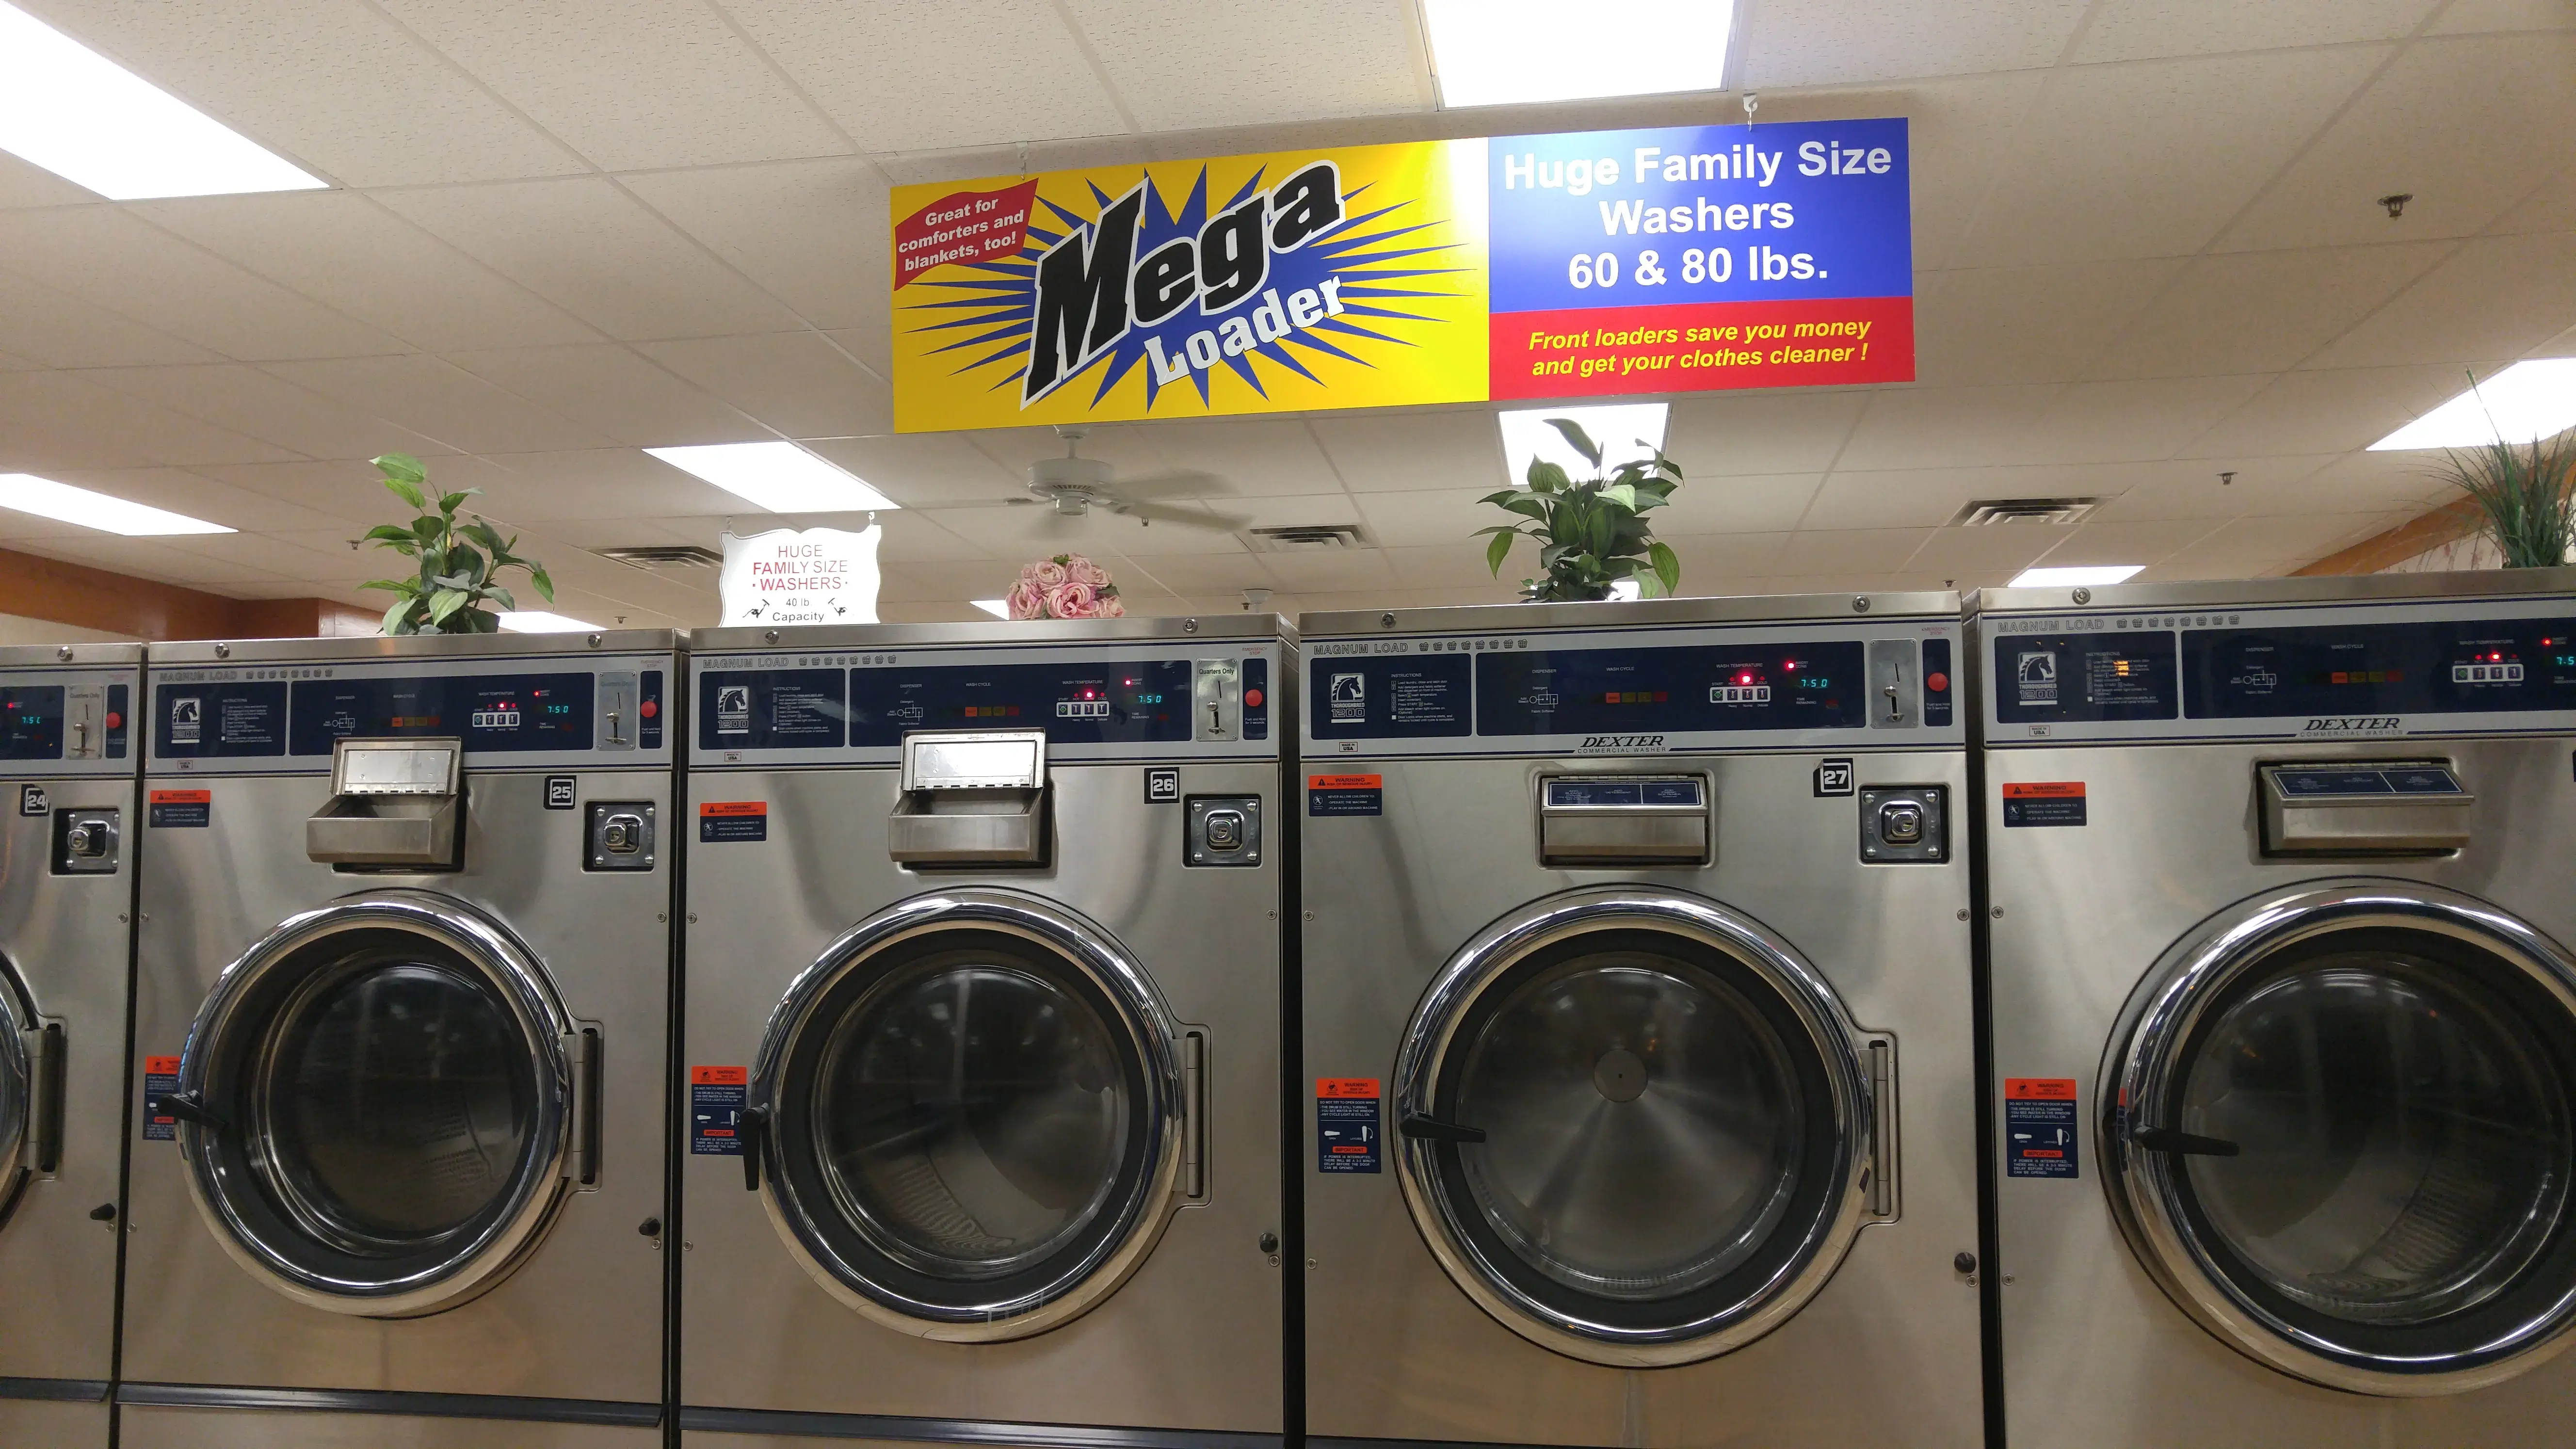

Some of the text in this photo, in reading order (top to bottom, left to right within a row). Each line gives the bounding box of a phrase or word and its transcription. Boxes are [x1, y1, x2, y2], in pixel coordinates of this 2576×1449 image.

[1505, 141, 1891, 195] Huge Family Size
[925, 198, 998, 226] Great for
[1599, 197, 1794, 236] Washers
[899, 209, 1024, 253] comforters and
[905, 231, 1016, 272] blankets, too!
[1568, 245, 1828, 289] 60 & 80 lbs.
[1019, 160, 1346, 411] Mega
[1144, 275, 1344, 387] Loader
[1529, 321, 1871, 350] Front loaders save you money
[1532, 356, 1574, 376] and
[1579, 354, 1616, 378] get
[1622, 354, 1674, 376] your
[1680, 350, 1763, 368] clothes
[778, 545, 822, 558] HUGE
[753, 561, 848, 575] FAMILY SIZE
[773, 612, 824, 623] Capacity
[1998, 619, 2104, 632] MAGNUM LOAD
[1314, 643, 1408, 655] MAGNUM LOAD
[703, 658, 789, 668] MAGNUM LOAD
[160, 671, 237, 681] MAGNUM LOAD
[2019, 690, 2057, 699] 1200
[1331, 708, 1365, 717] 1200
[718, 720, 748, 728] 1200
[2303, 718, 2399, 730] DEXTER
[1580, 736, 1664, 747] DEXTER
[1824, 770, 1847, 784] 27
[1153, 779, 1174, 791] 26
[553, 787, 571, 798] 25
[28, 795, 47, 807] 24
